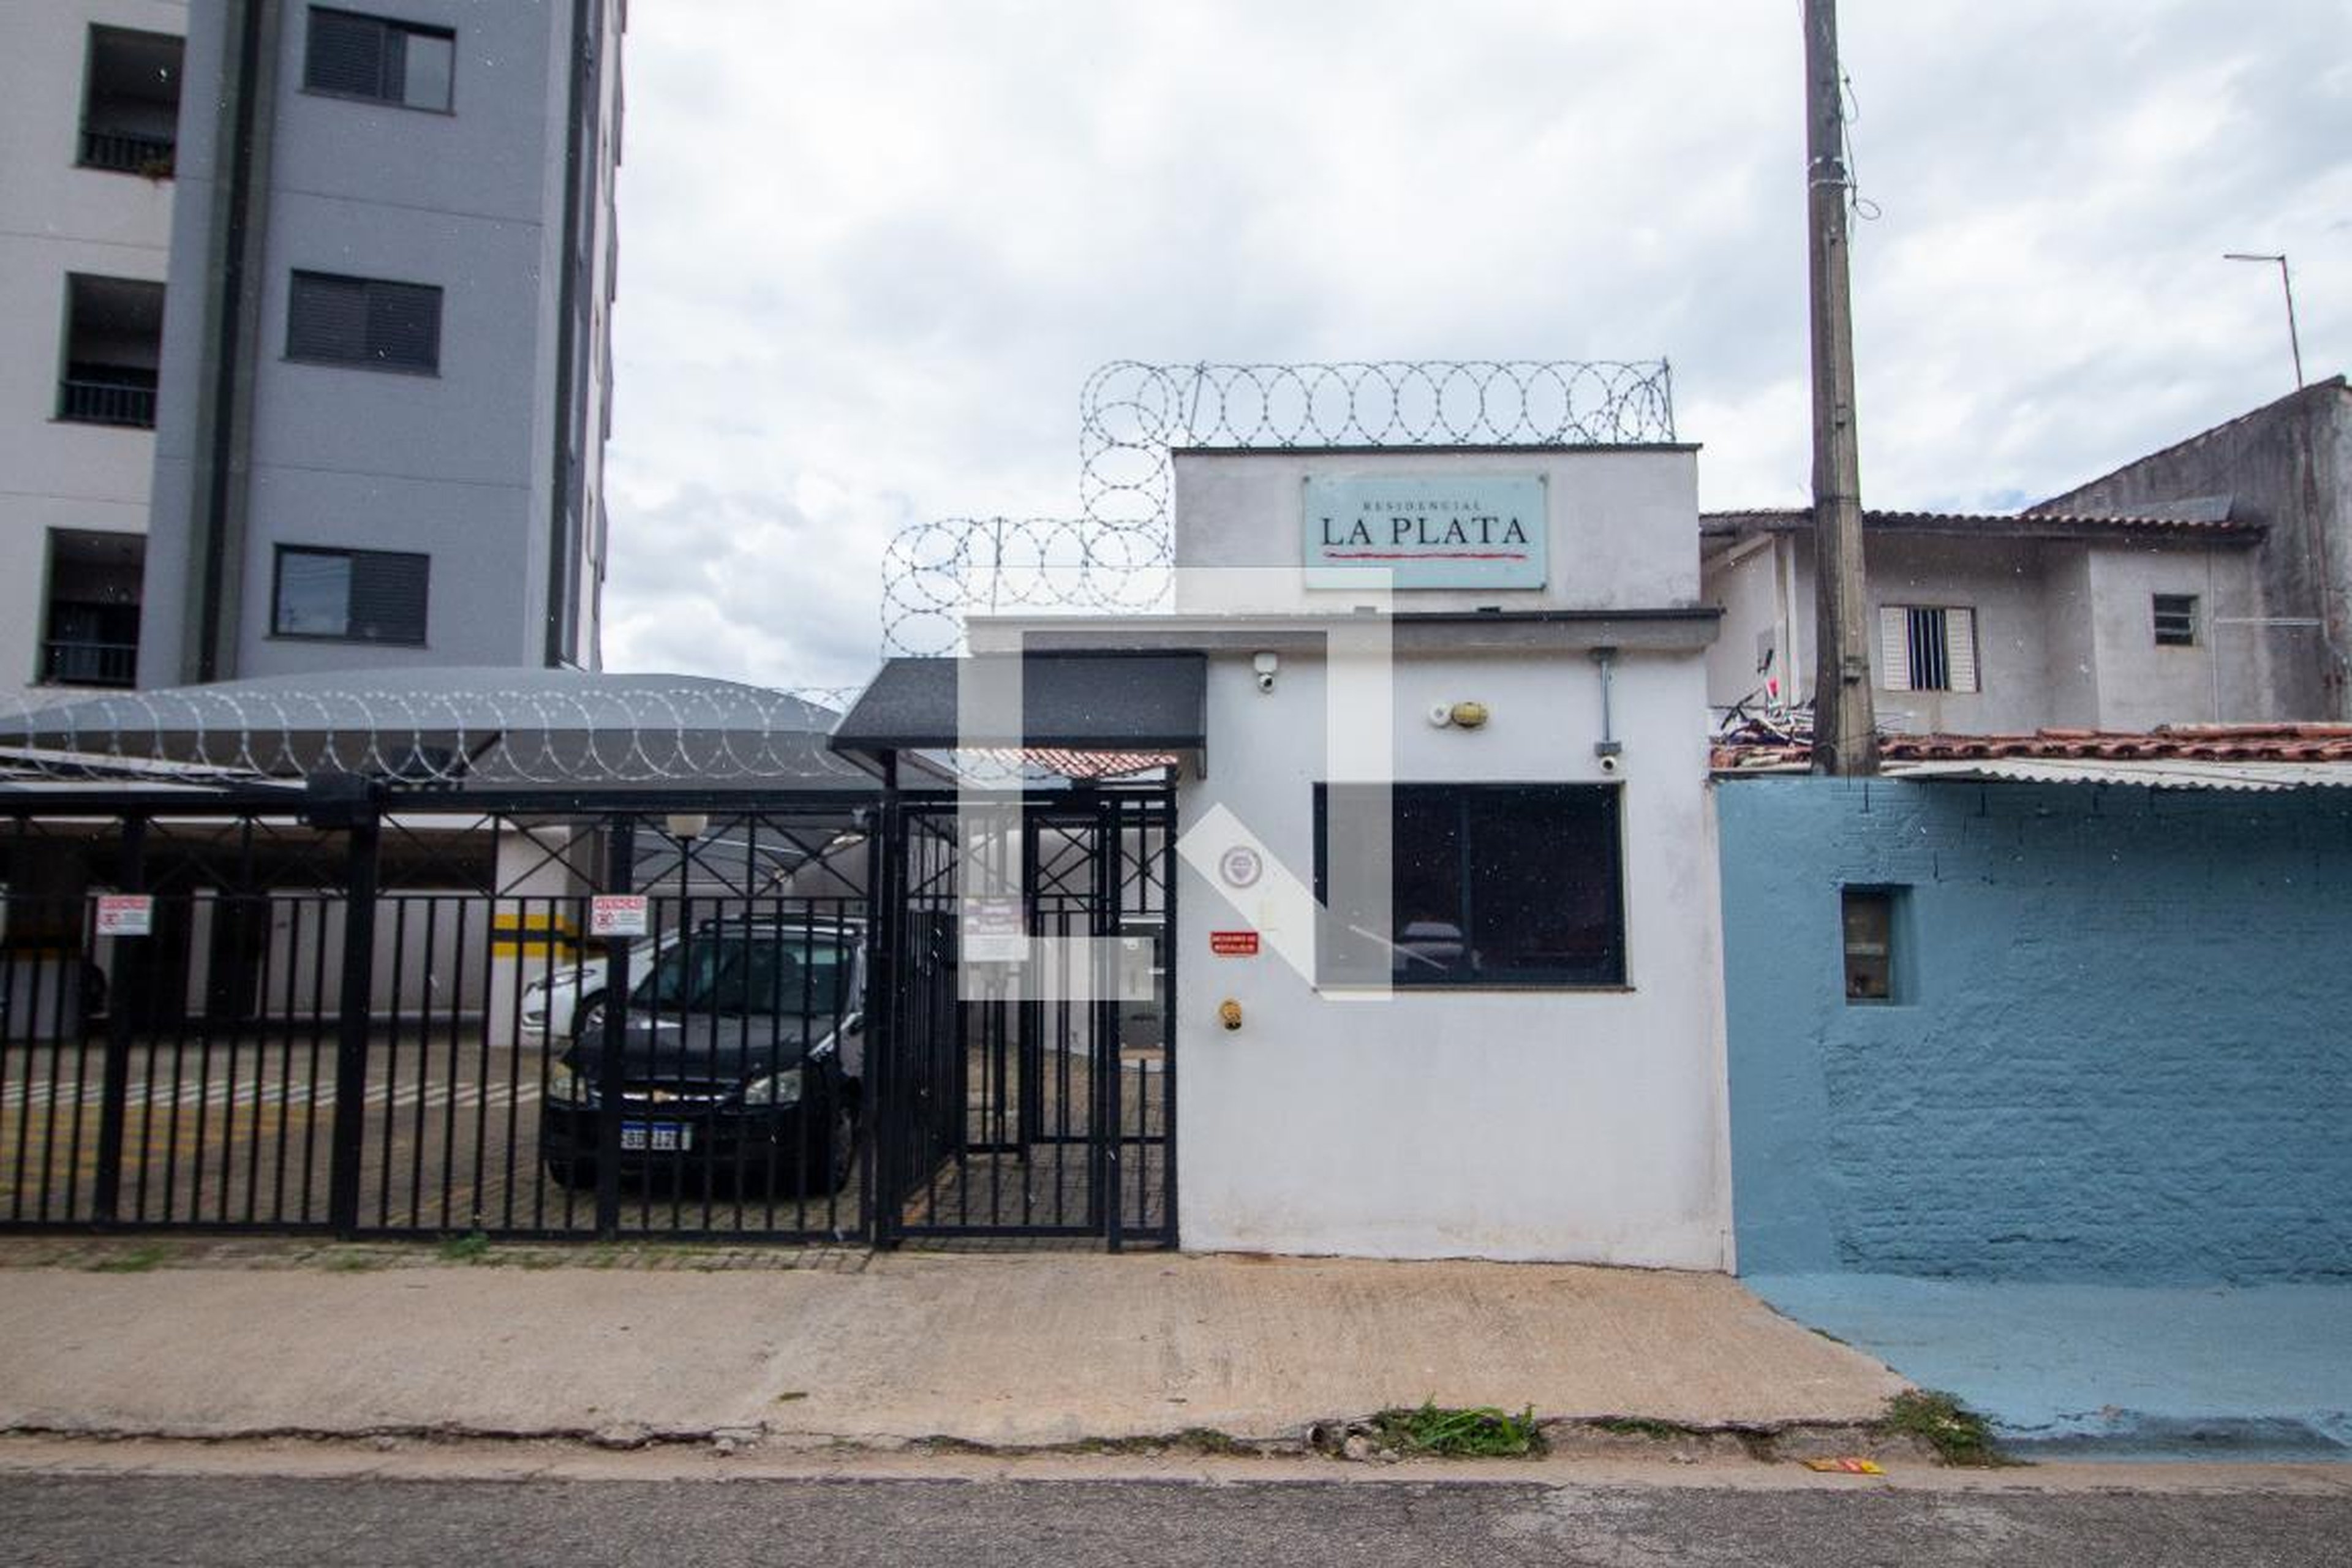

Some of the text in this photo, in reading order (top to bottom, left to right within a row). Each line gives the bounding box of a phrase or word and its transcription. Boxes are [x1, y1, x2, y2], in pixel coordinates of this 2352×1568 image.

[1363, 500, 1481, 511] RESIDENCIAL
[1322, 518, 1528, 545] LA PLATA
